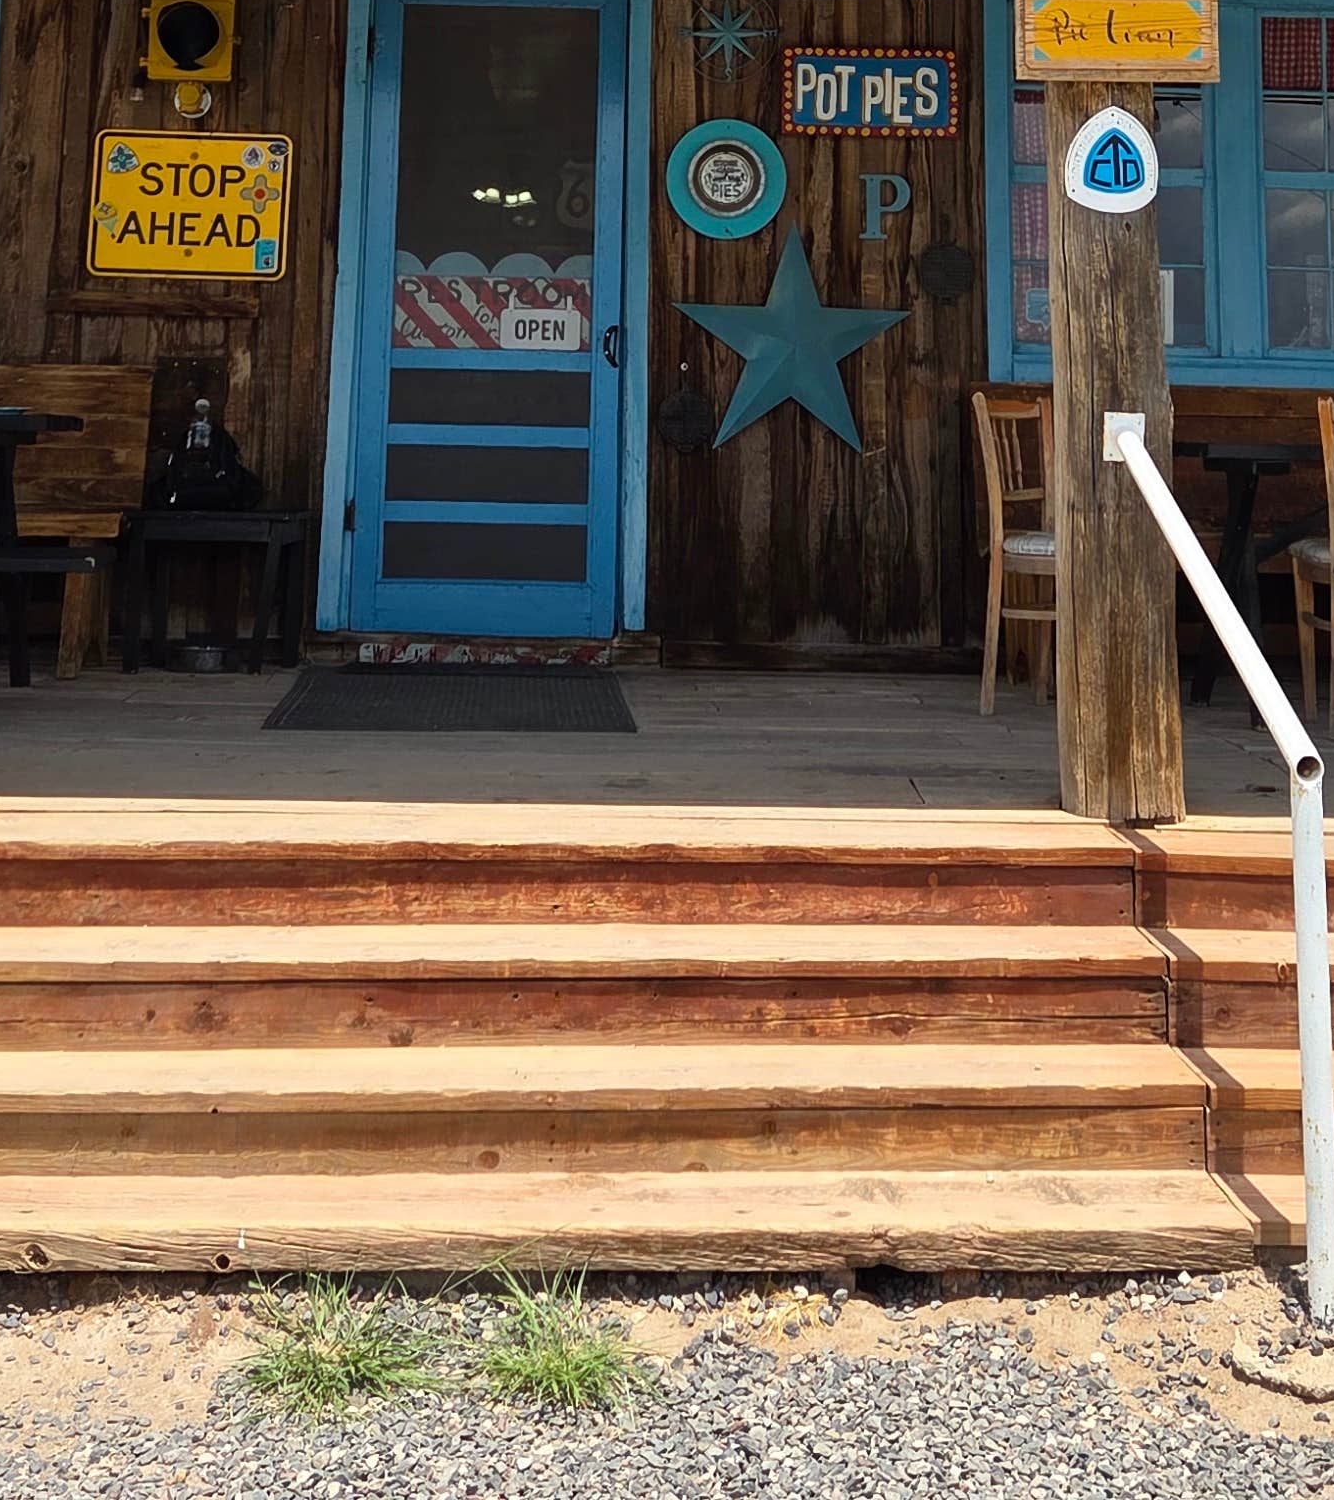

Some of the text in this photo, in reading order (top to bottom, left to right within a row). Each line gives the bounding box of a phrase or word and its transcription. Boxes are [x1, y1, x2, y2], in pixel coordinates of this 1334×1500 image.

[795, 63, 940, 124] POT PIES
[138, 162, 246, 198] STOP
[711, 183, 742, 198] PIES
[859, 174, 911, 240] P
[116, 210, 261, 248] AHEAD
[514, 318, 566, 341] OPEN
